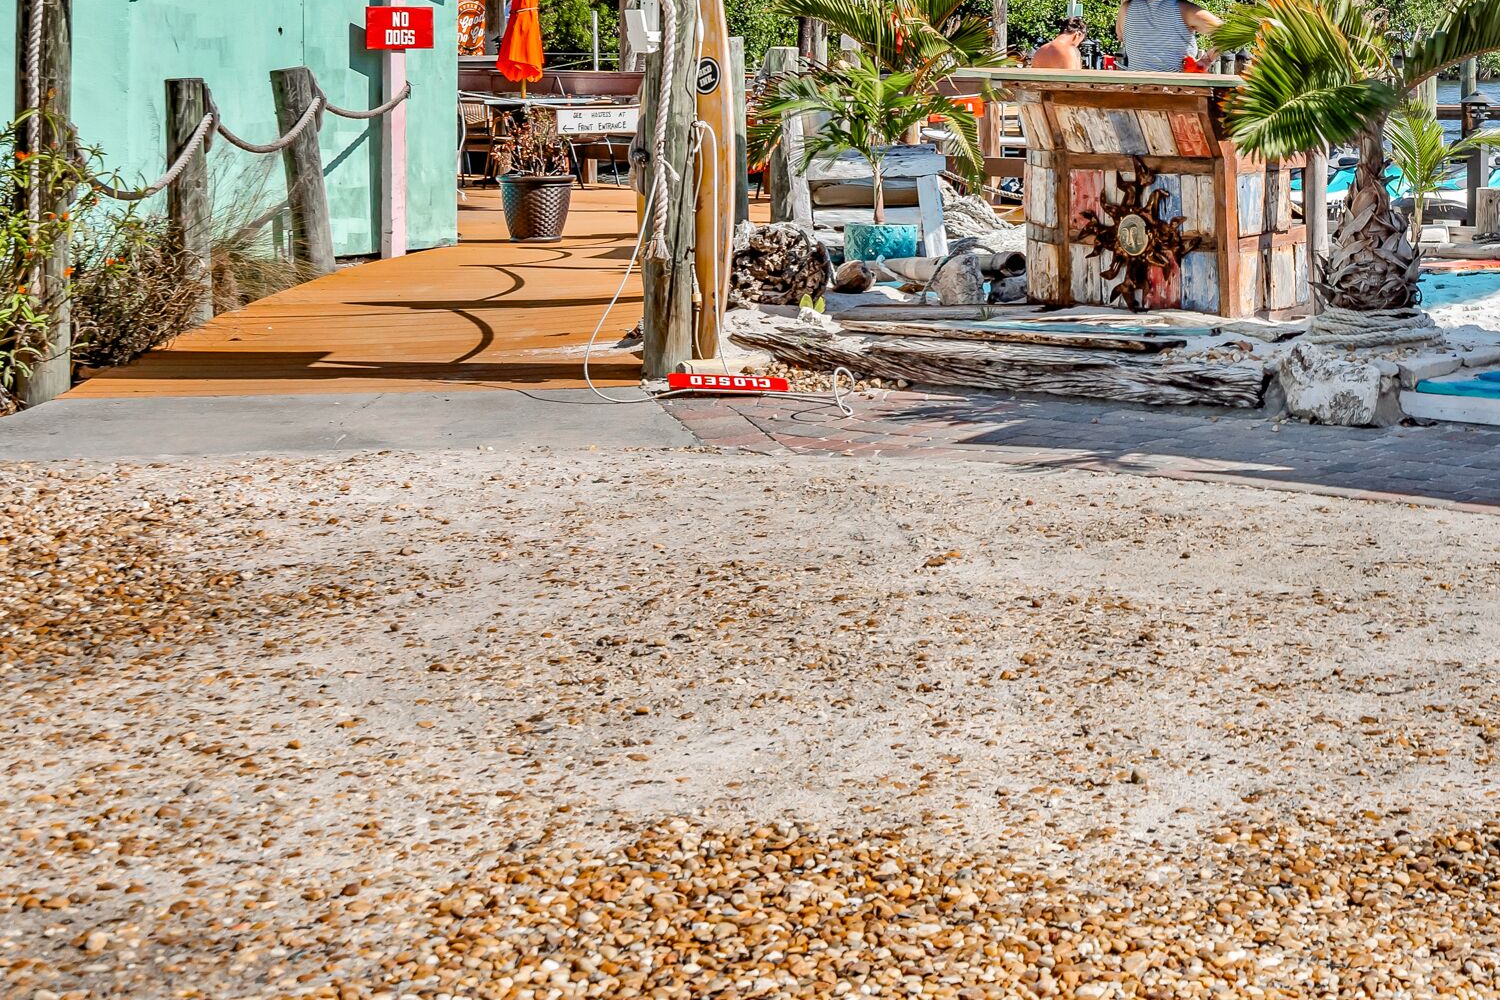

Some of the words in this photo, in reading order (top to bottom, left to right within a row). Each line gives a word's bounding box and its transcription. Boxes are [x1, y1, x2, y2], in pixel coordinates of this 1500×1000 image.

[392, 11, 409, 27] NO
[385, 29, 415, 45] DOGS
[578, 122, 593, 131] FRONT
[598, 120, 627, 130] ENTRANCE
[690, 375, 771, 388] CLOSED
